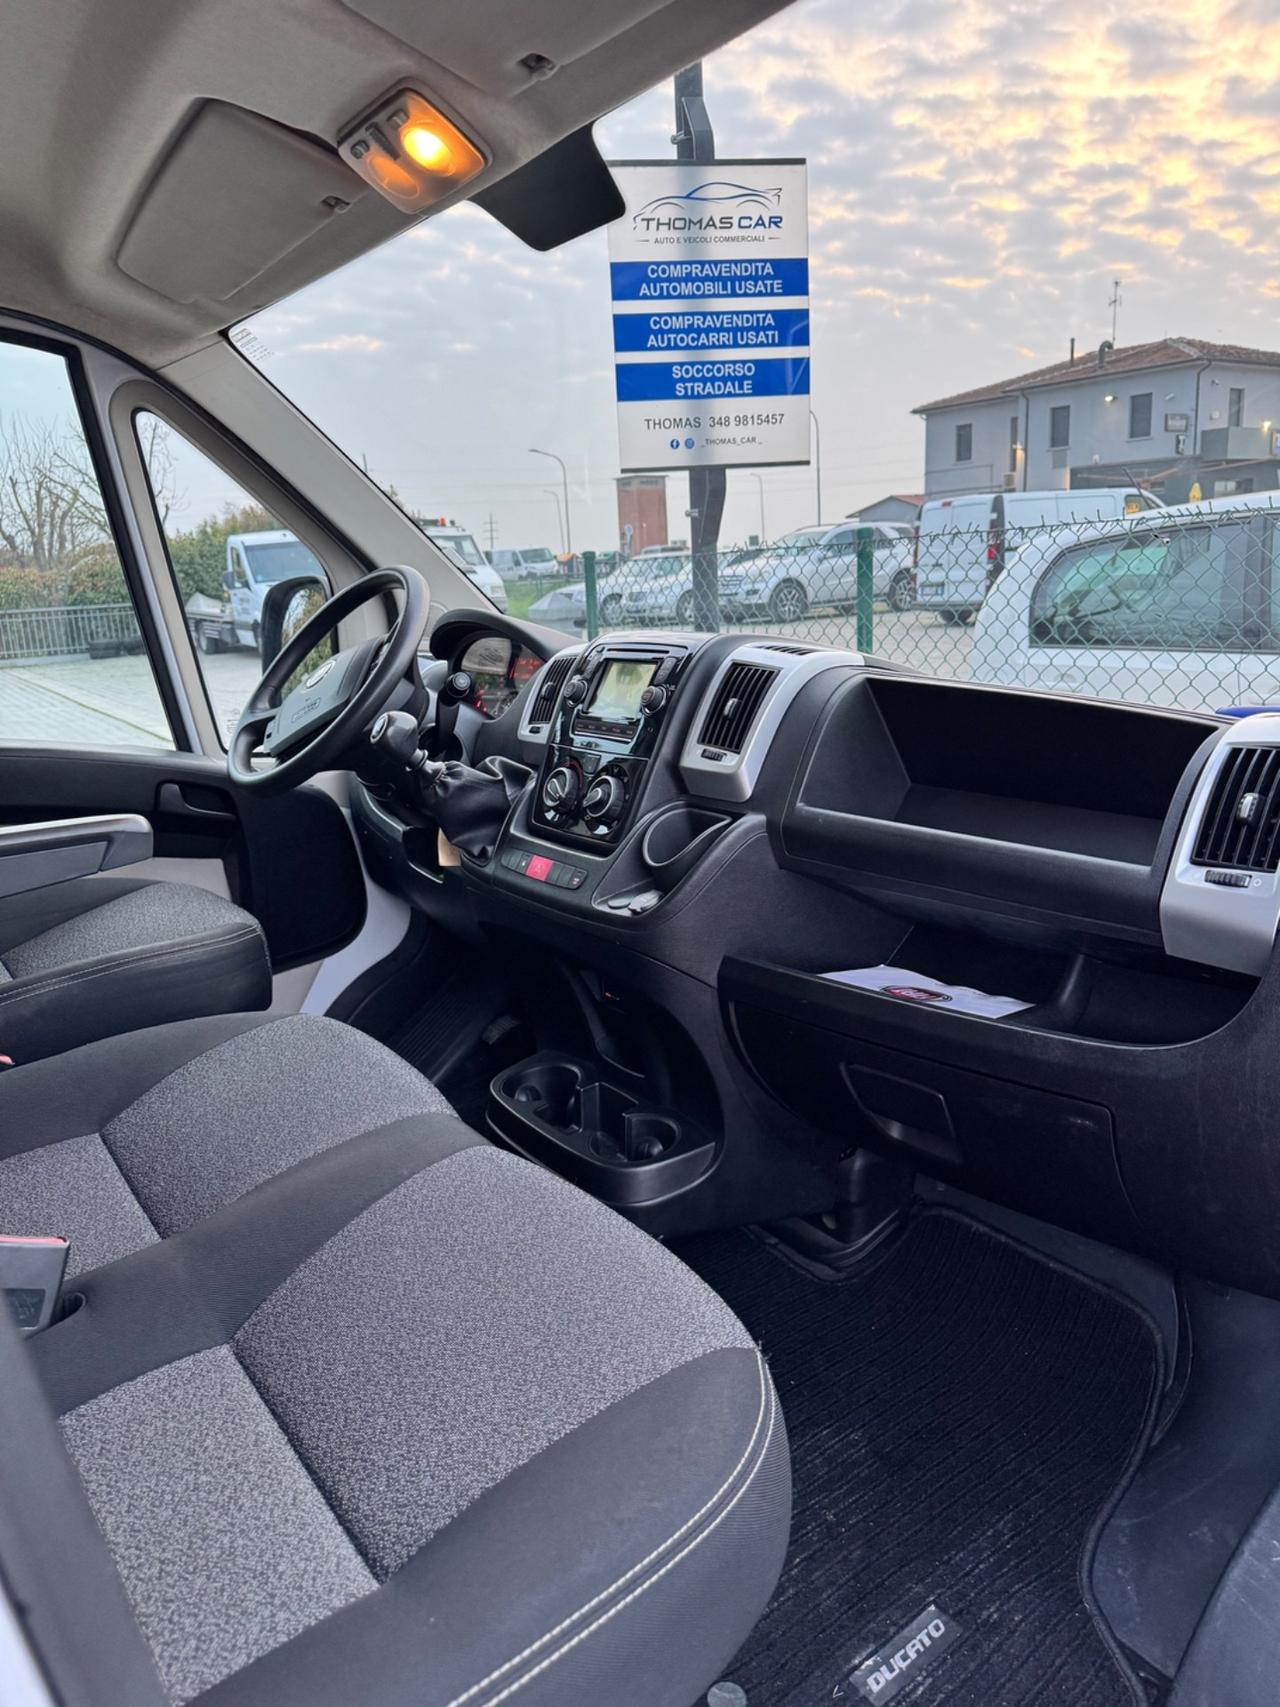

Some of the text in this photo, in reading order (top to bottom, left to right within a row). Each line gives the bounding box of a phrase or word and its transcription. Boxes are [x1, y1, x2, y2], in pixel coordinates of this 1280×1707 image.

[641, 214, 783, 231] THOMAS CAR
[654, 235, 765, 244] AUTO E VEICOLI COMMERCIALI
[647, 262, 774, 278] COMPRAVENDITA
[639, 280, 782, 296] AUTOMOBILI USATE
[650, 313, 775, 329] COMPRAVENDITA
[647, 330, 778, 347] AUTOCARRI USATI
[672, 363, 755, 378] SOCCORSO
[675, 381, 752, 395] STRADALE
[644, 413, 785, 430] THOMAS 348 9815457
[866, 1619, 945, 1694] DUCATO
